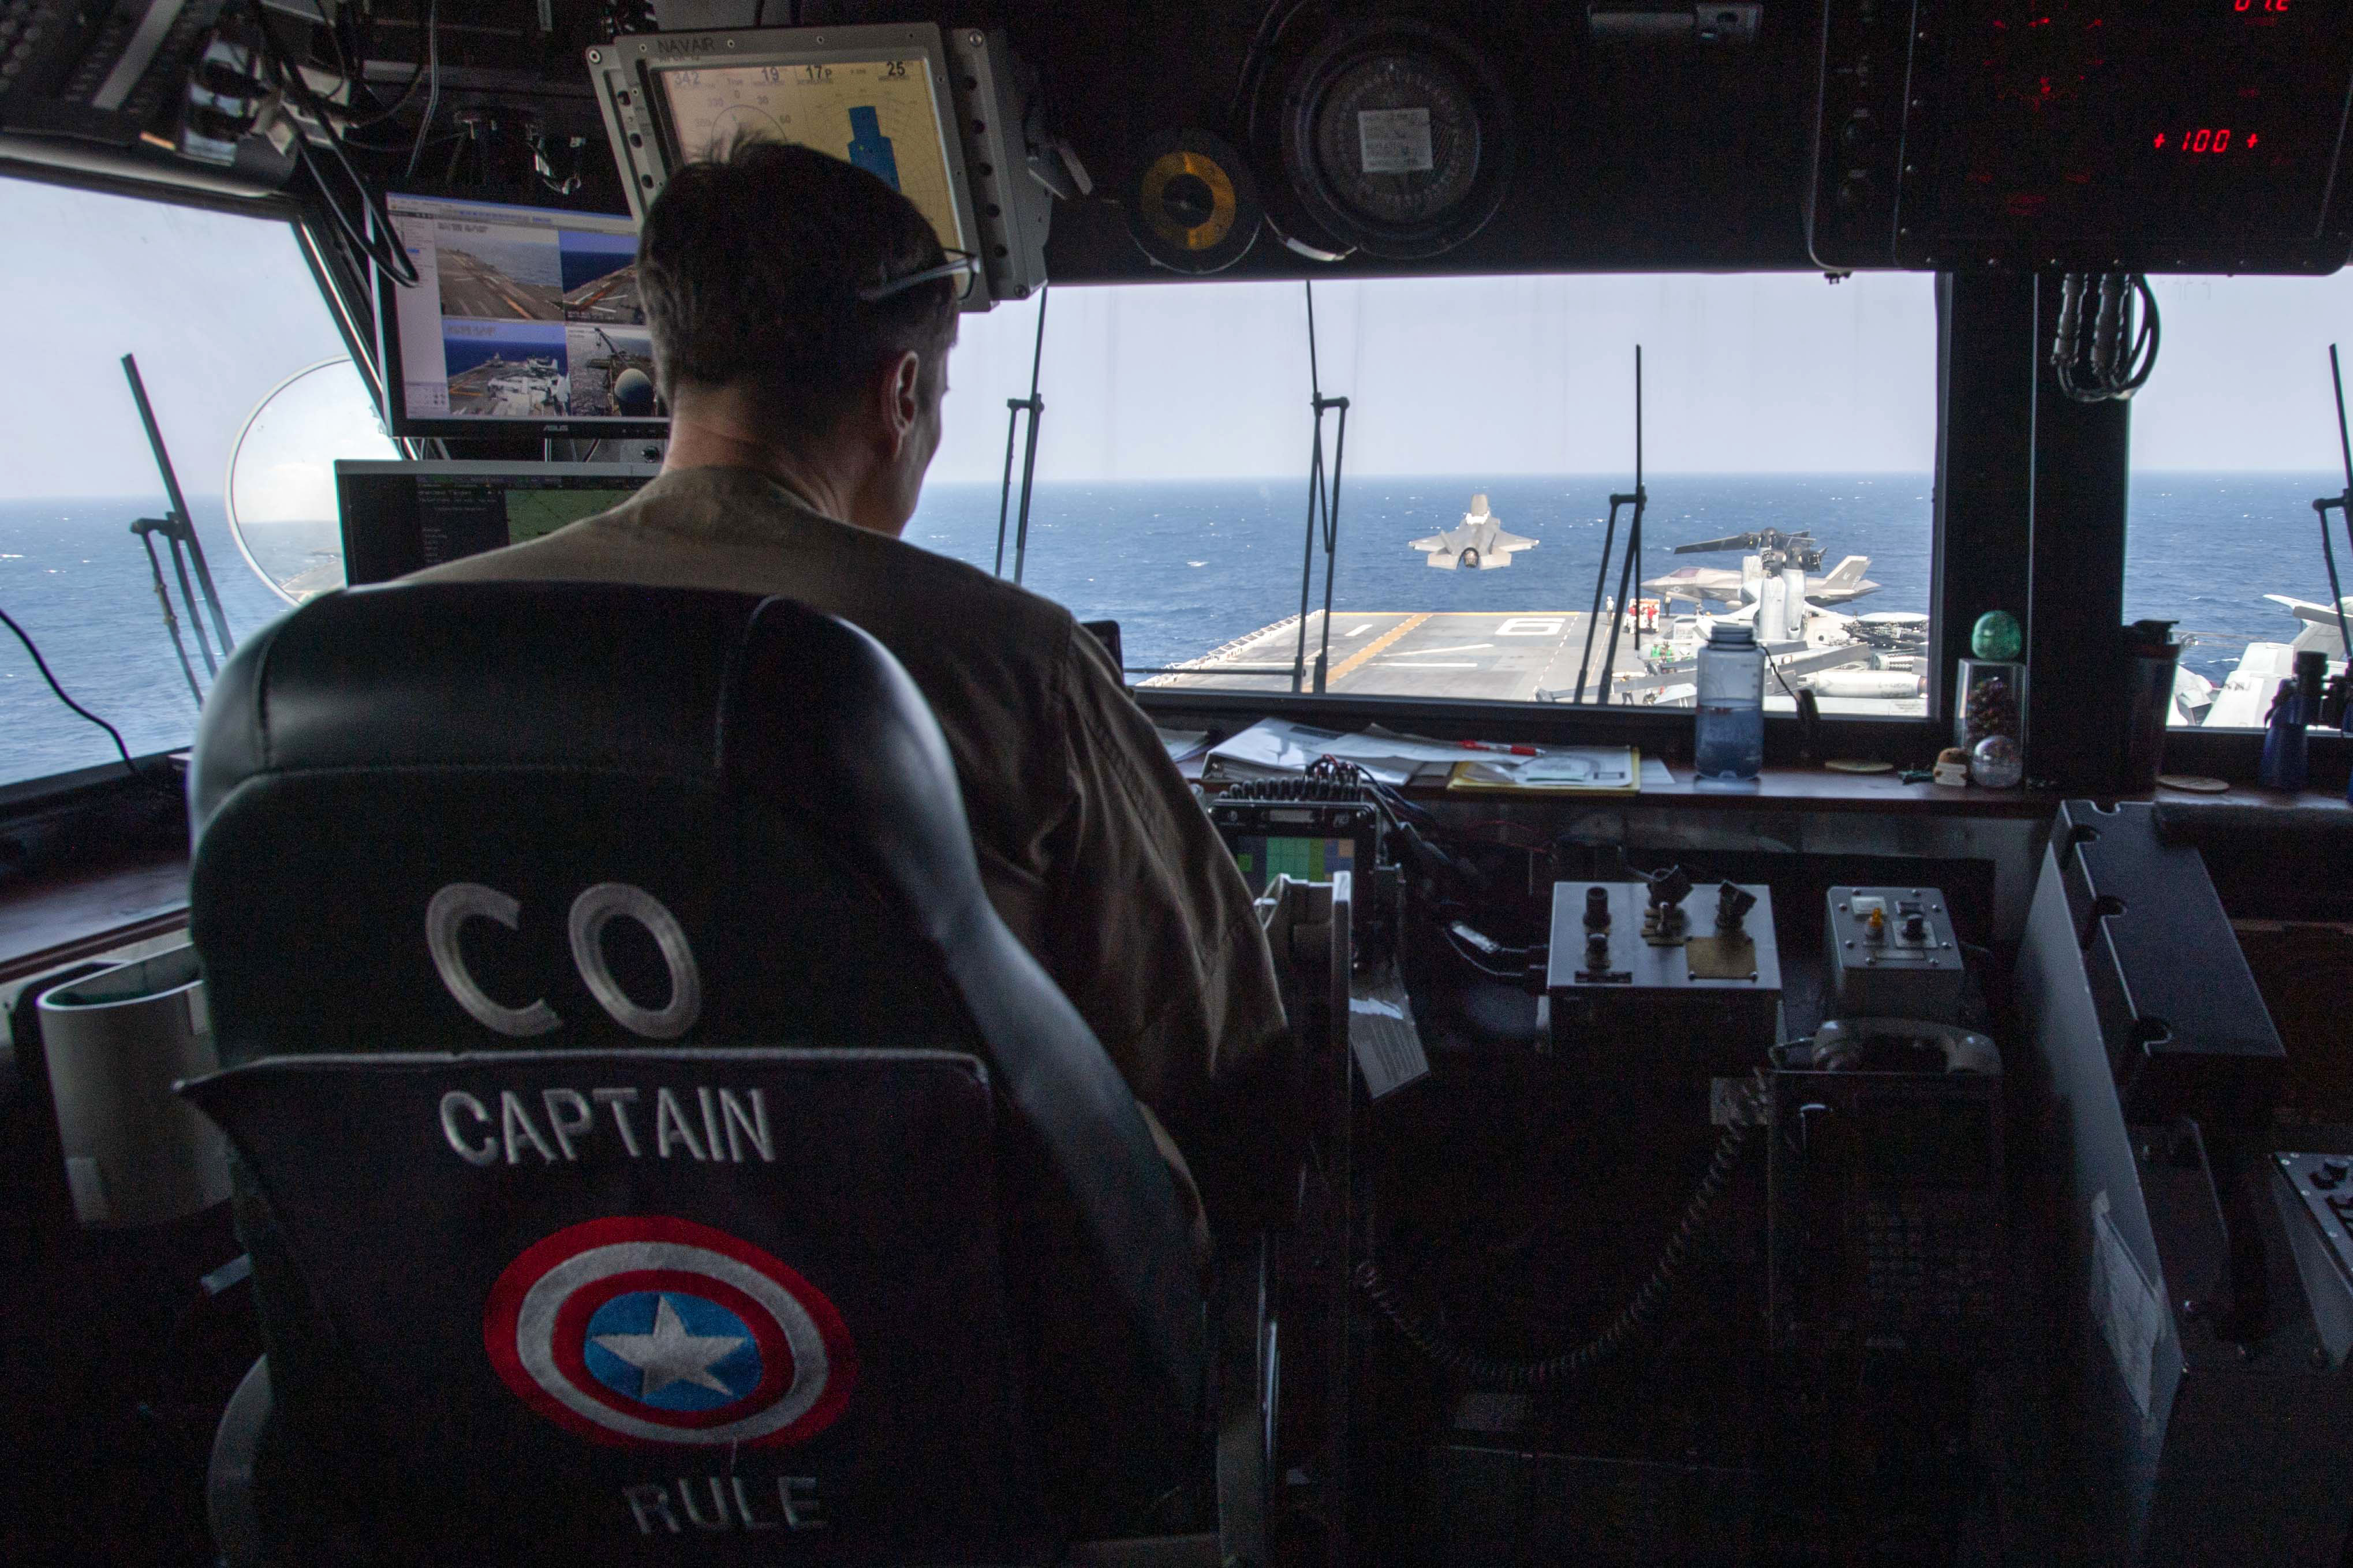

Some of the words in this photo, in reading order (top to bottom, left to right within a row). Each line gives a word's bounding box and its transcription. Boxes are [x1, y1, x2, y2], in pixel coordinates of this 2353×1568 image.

[657, 36, 715, 55] NAVAIR
[761, 65, 779, 83] 19
[886, 60, 906, 77] 25
[2182, 129, 2231, 153] 100
[1495, 618, 1566, 635] 6
[438, 1086, 776, 1165] CAPTAIN
[623, 1476, 829, 1536] RULE
